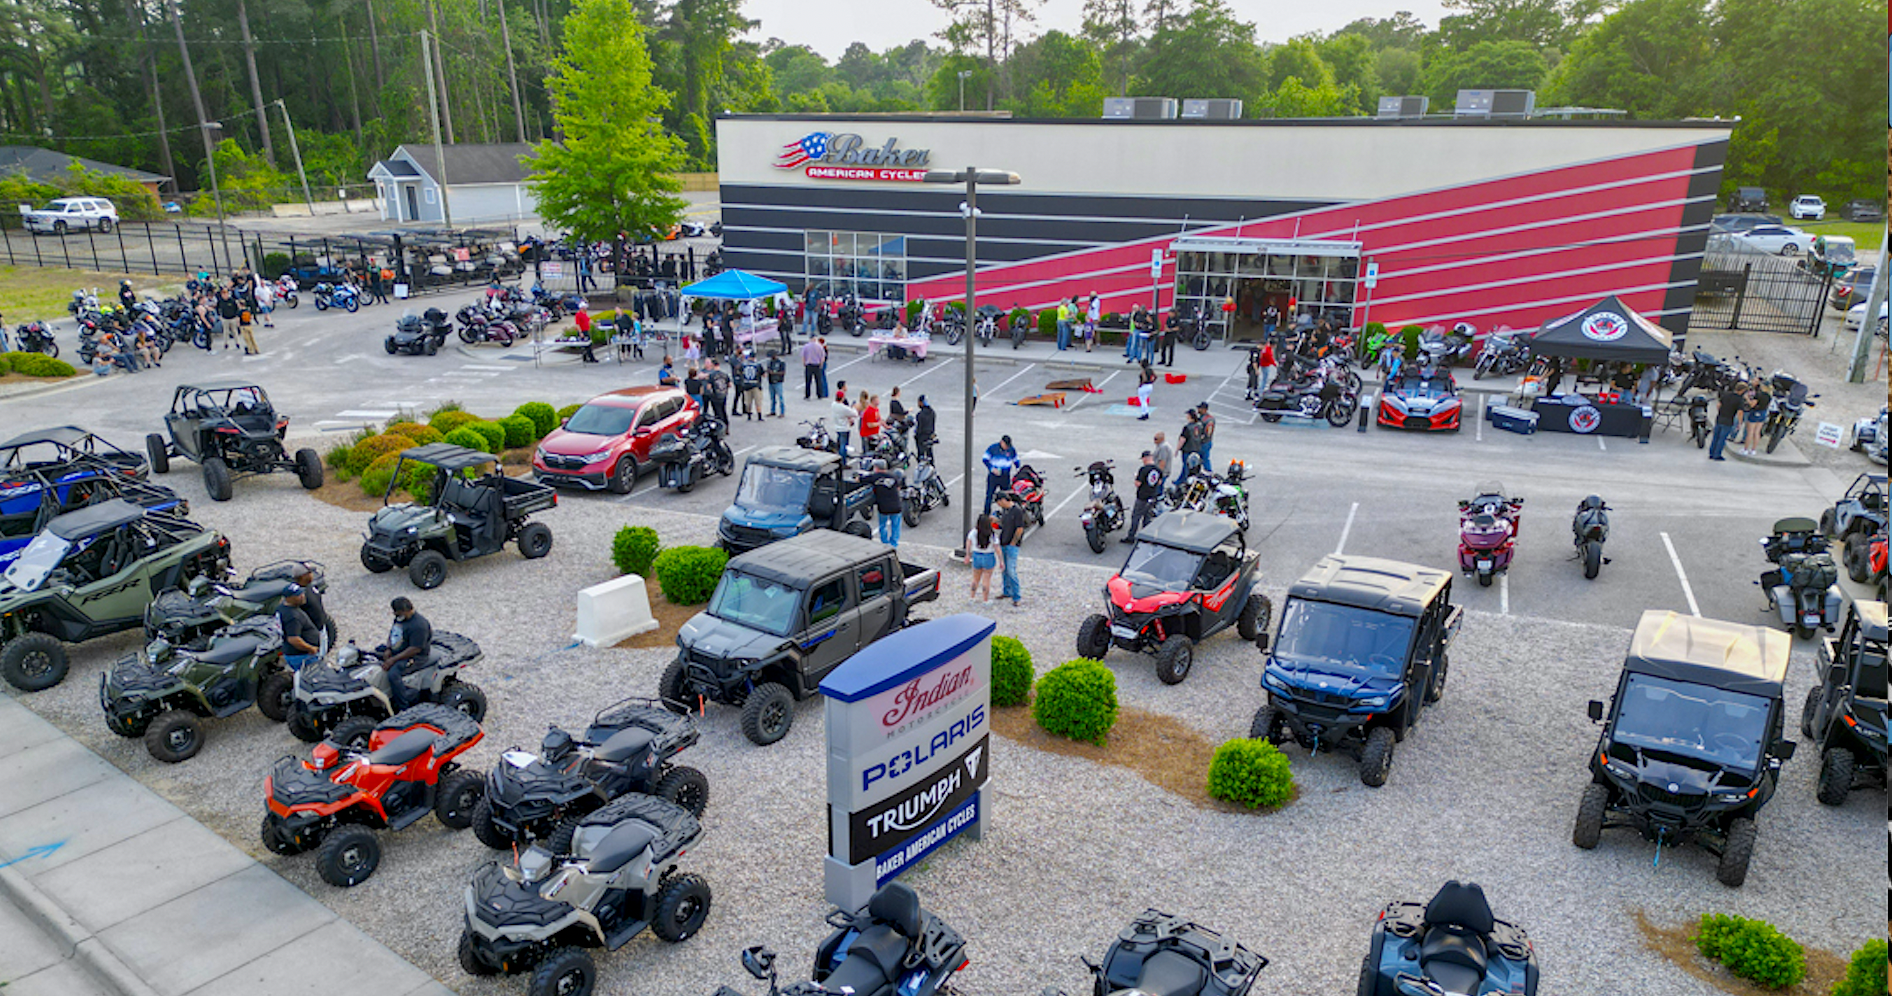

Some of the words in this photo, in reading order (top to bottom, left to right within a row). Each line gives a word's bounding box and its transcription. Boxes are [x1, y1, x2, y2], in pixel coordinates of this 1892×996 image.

[808, 167, 875, 179] AMERICAN
[822, 133, 931, 166] Baker
[882, 664, 972, 727] Indian
[887, 689, 970, 739] MOTORCYCLE
[862, 703, 985, 792] POLARIS
[866, 768, 961, 838] TRIUMPH
[876, 850, 905, 880] BAKER
[905, 823, 947, 862] AMERICAN
[947, 803, 976, 834] CYCLES
